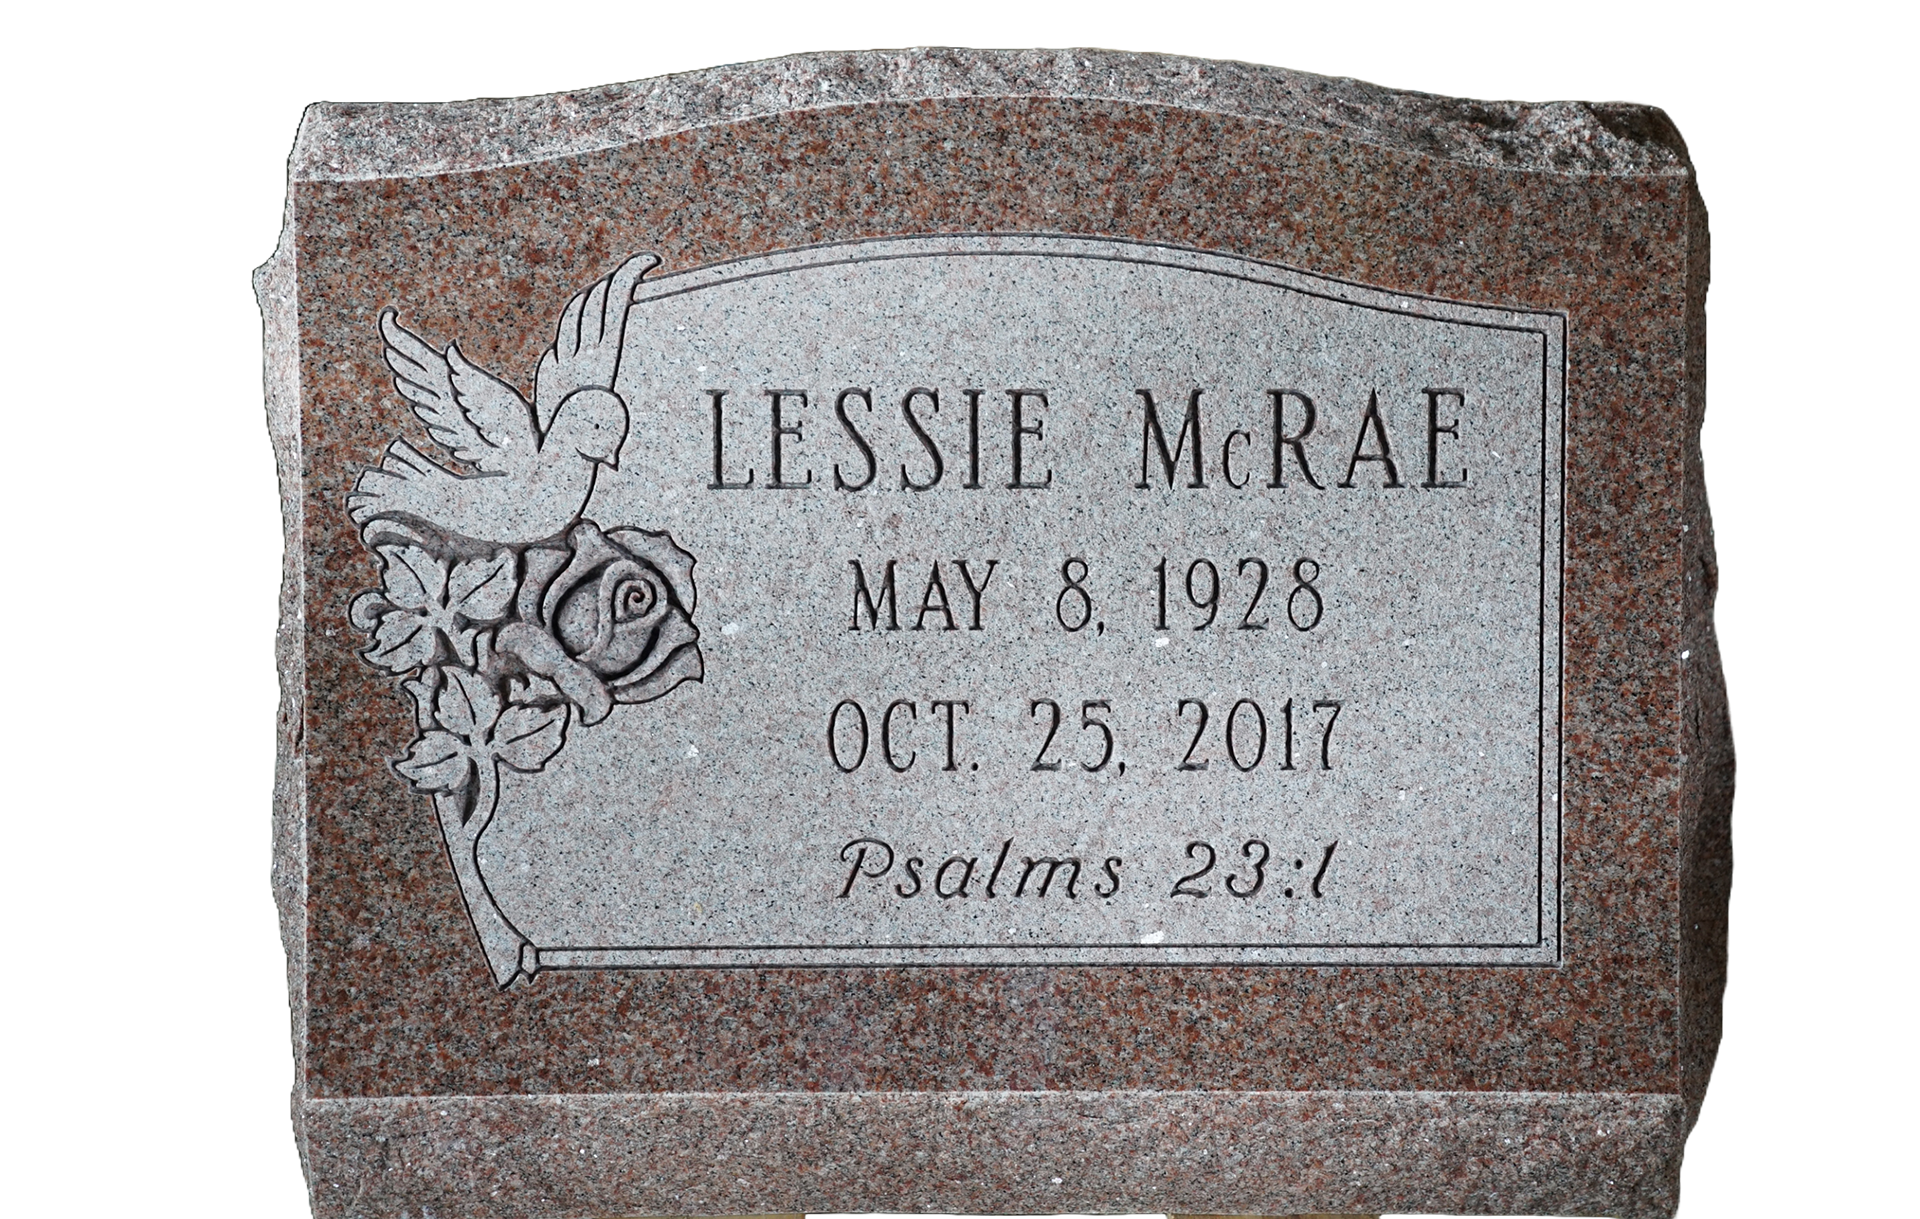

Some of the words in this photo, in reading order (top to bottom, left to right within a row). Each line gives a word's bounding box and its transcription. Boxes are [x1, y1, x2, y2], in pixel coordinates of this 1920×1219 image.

[707, 387, 1053, 491] LESSIE
[849, 558, 996, 632] MAY
[1056, 557, 1106, 638] 8,
[1155, 557, 1325, 632] 1928
[828, 699, 978, 774] OCT.
[1031, 699, 1125, 779] 25,
[1178, 697, 1343, 773] 2017
[838, 837, 1124, 900] Psalms
[1169, 838, 1338, 900] 23:1
